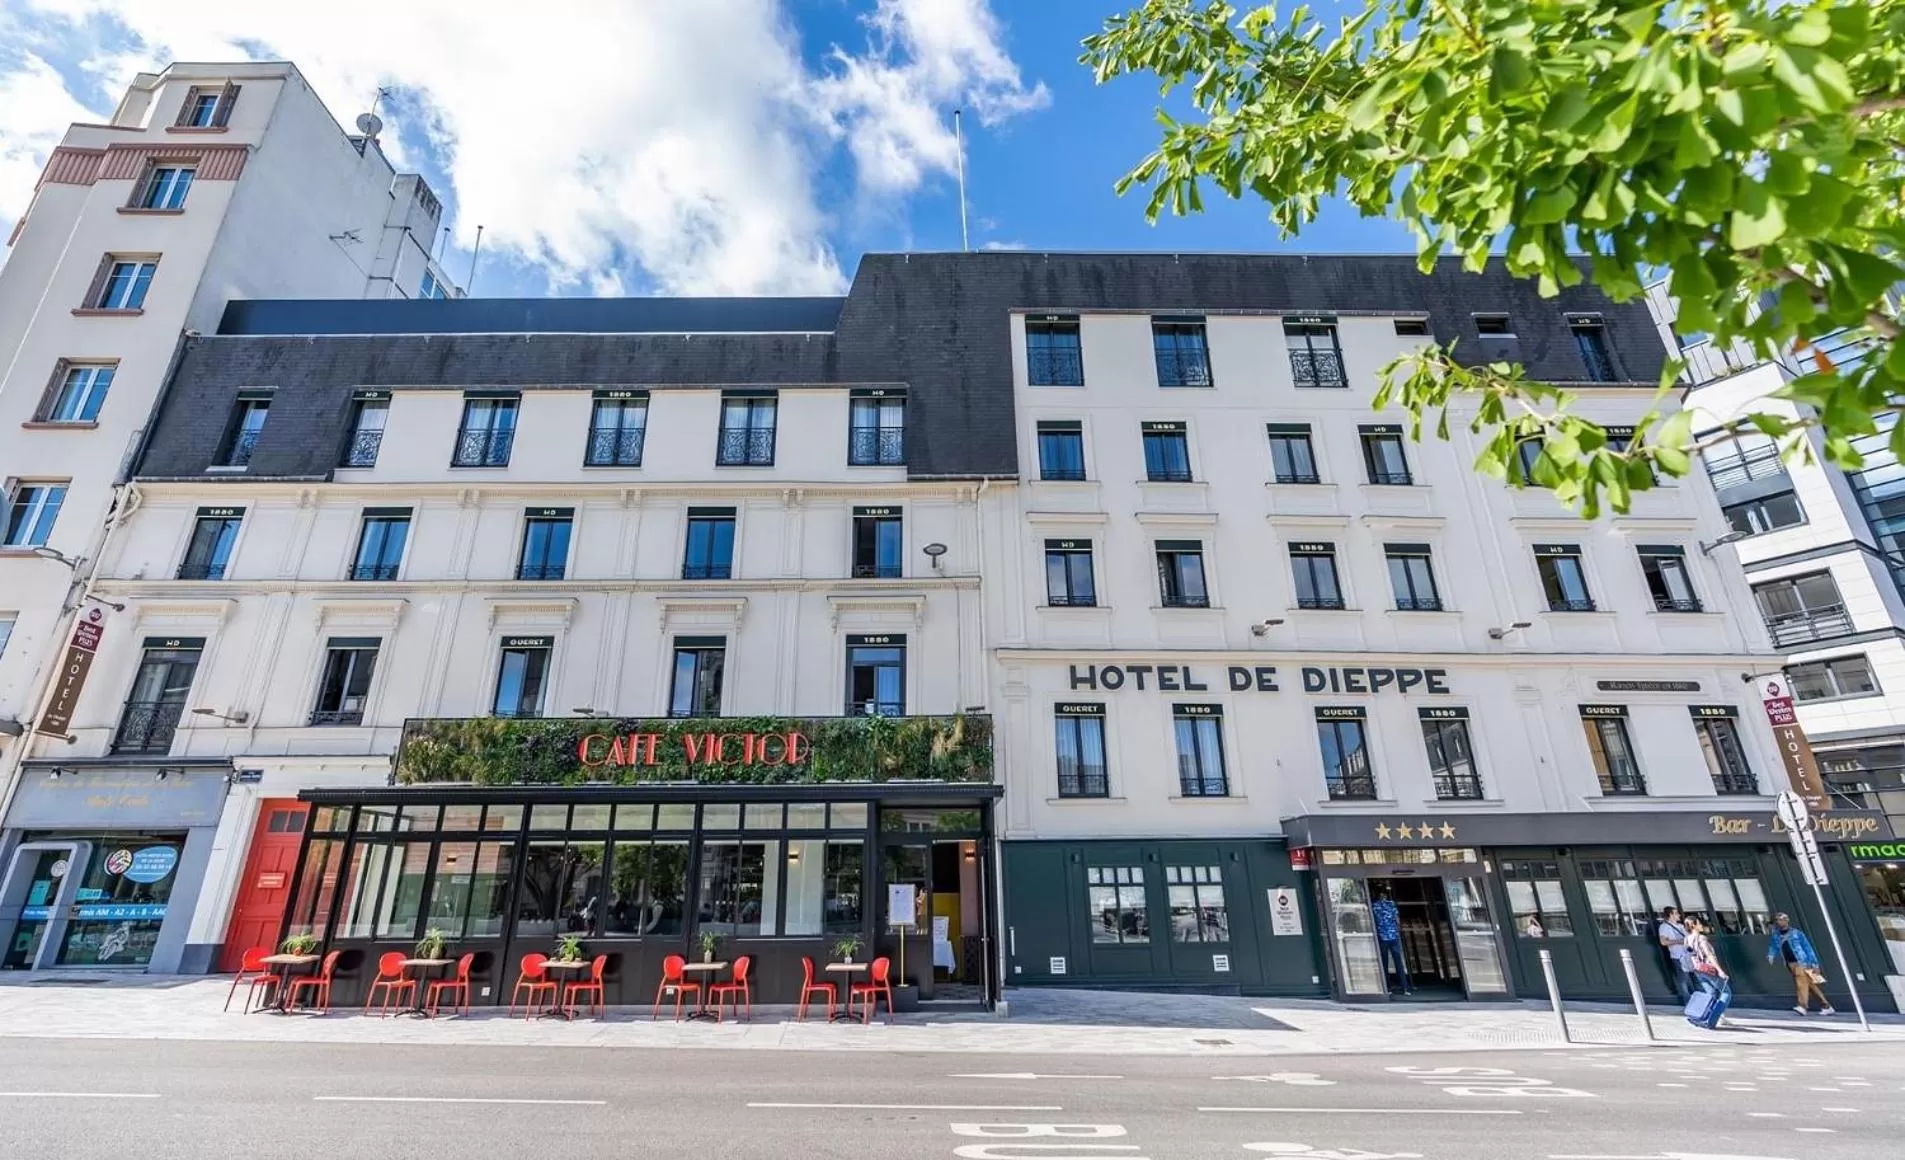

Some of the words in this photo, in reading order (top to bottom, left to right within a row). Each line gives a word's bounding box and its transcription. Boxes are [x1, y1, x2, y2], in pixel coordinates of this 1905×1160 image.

[58, 653, 84, 712] HOTEL
[1070, 665, 1207, 691] HOTEL
[1228, 666, 1279, 692] DE
[1301, 667, 1449, 694] DIEPPE
[685, 732, 809, 766] VICTOR
[1784, 729, 1811, 791] HOTEL
[1709, 815, 1752, 834] Bar
